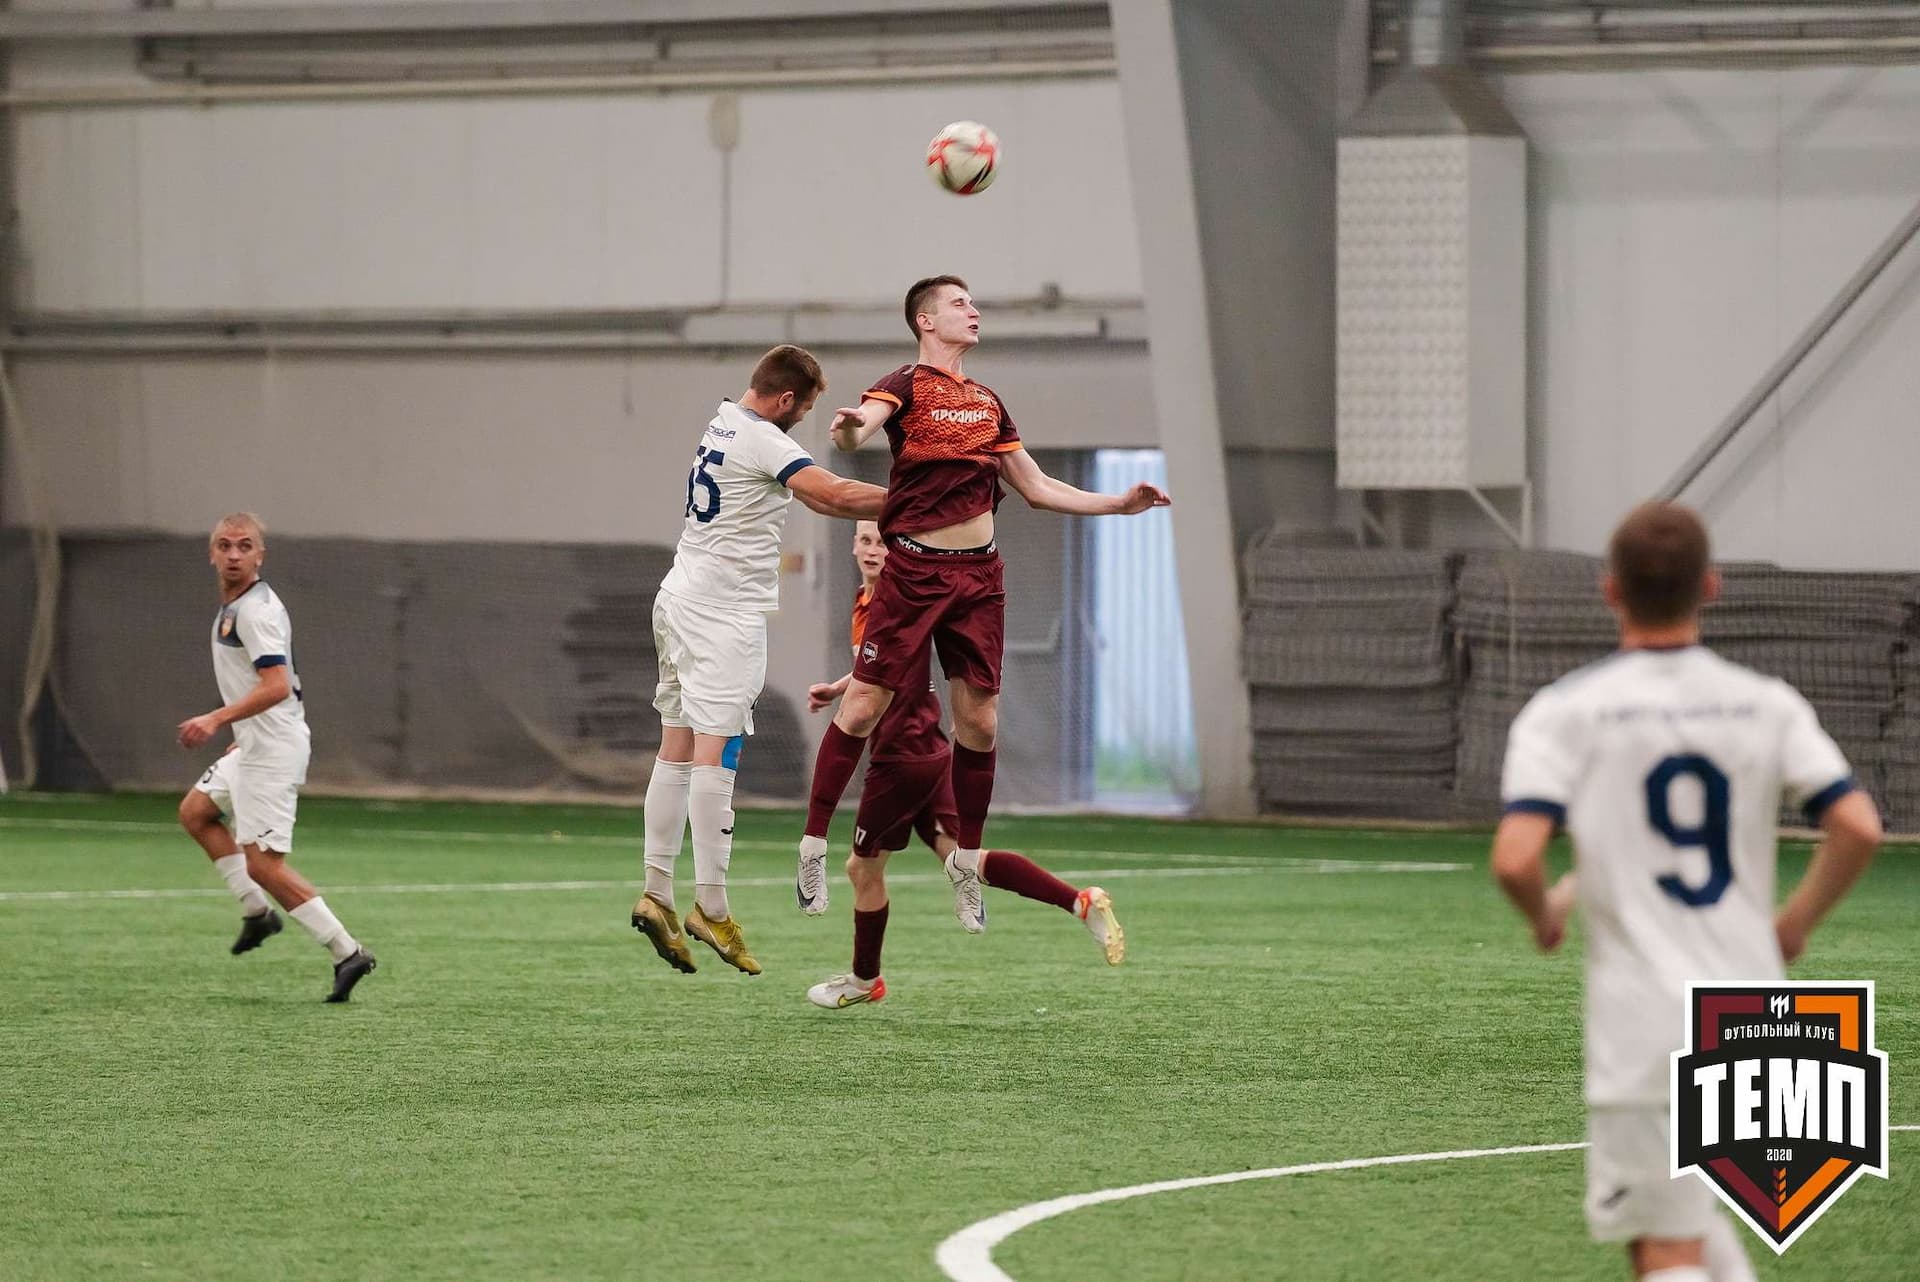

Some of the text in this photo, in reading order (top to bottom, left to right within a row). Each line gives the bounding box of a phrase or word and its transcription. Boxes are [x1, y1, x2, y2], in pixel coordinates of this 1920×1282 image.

[685, 446, 725, 523] 15
[855, 826, 867, 846] 17
[1645, 752, 1733, 907] 9
